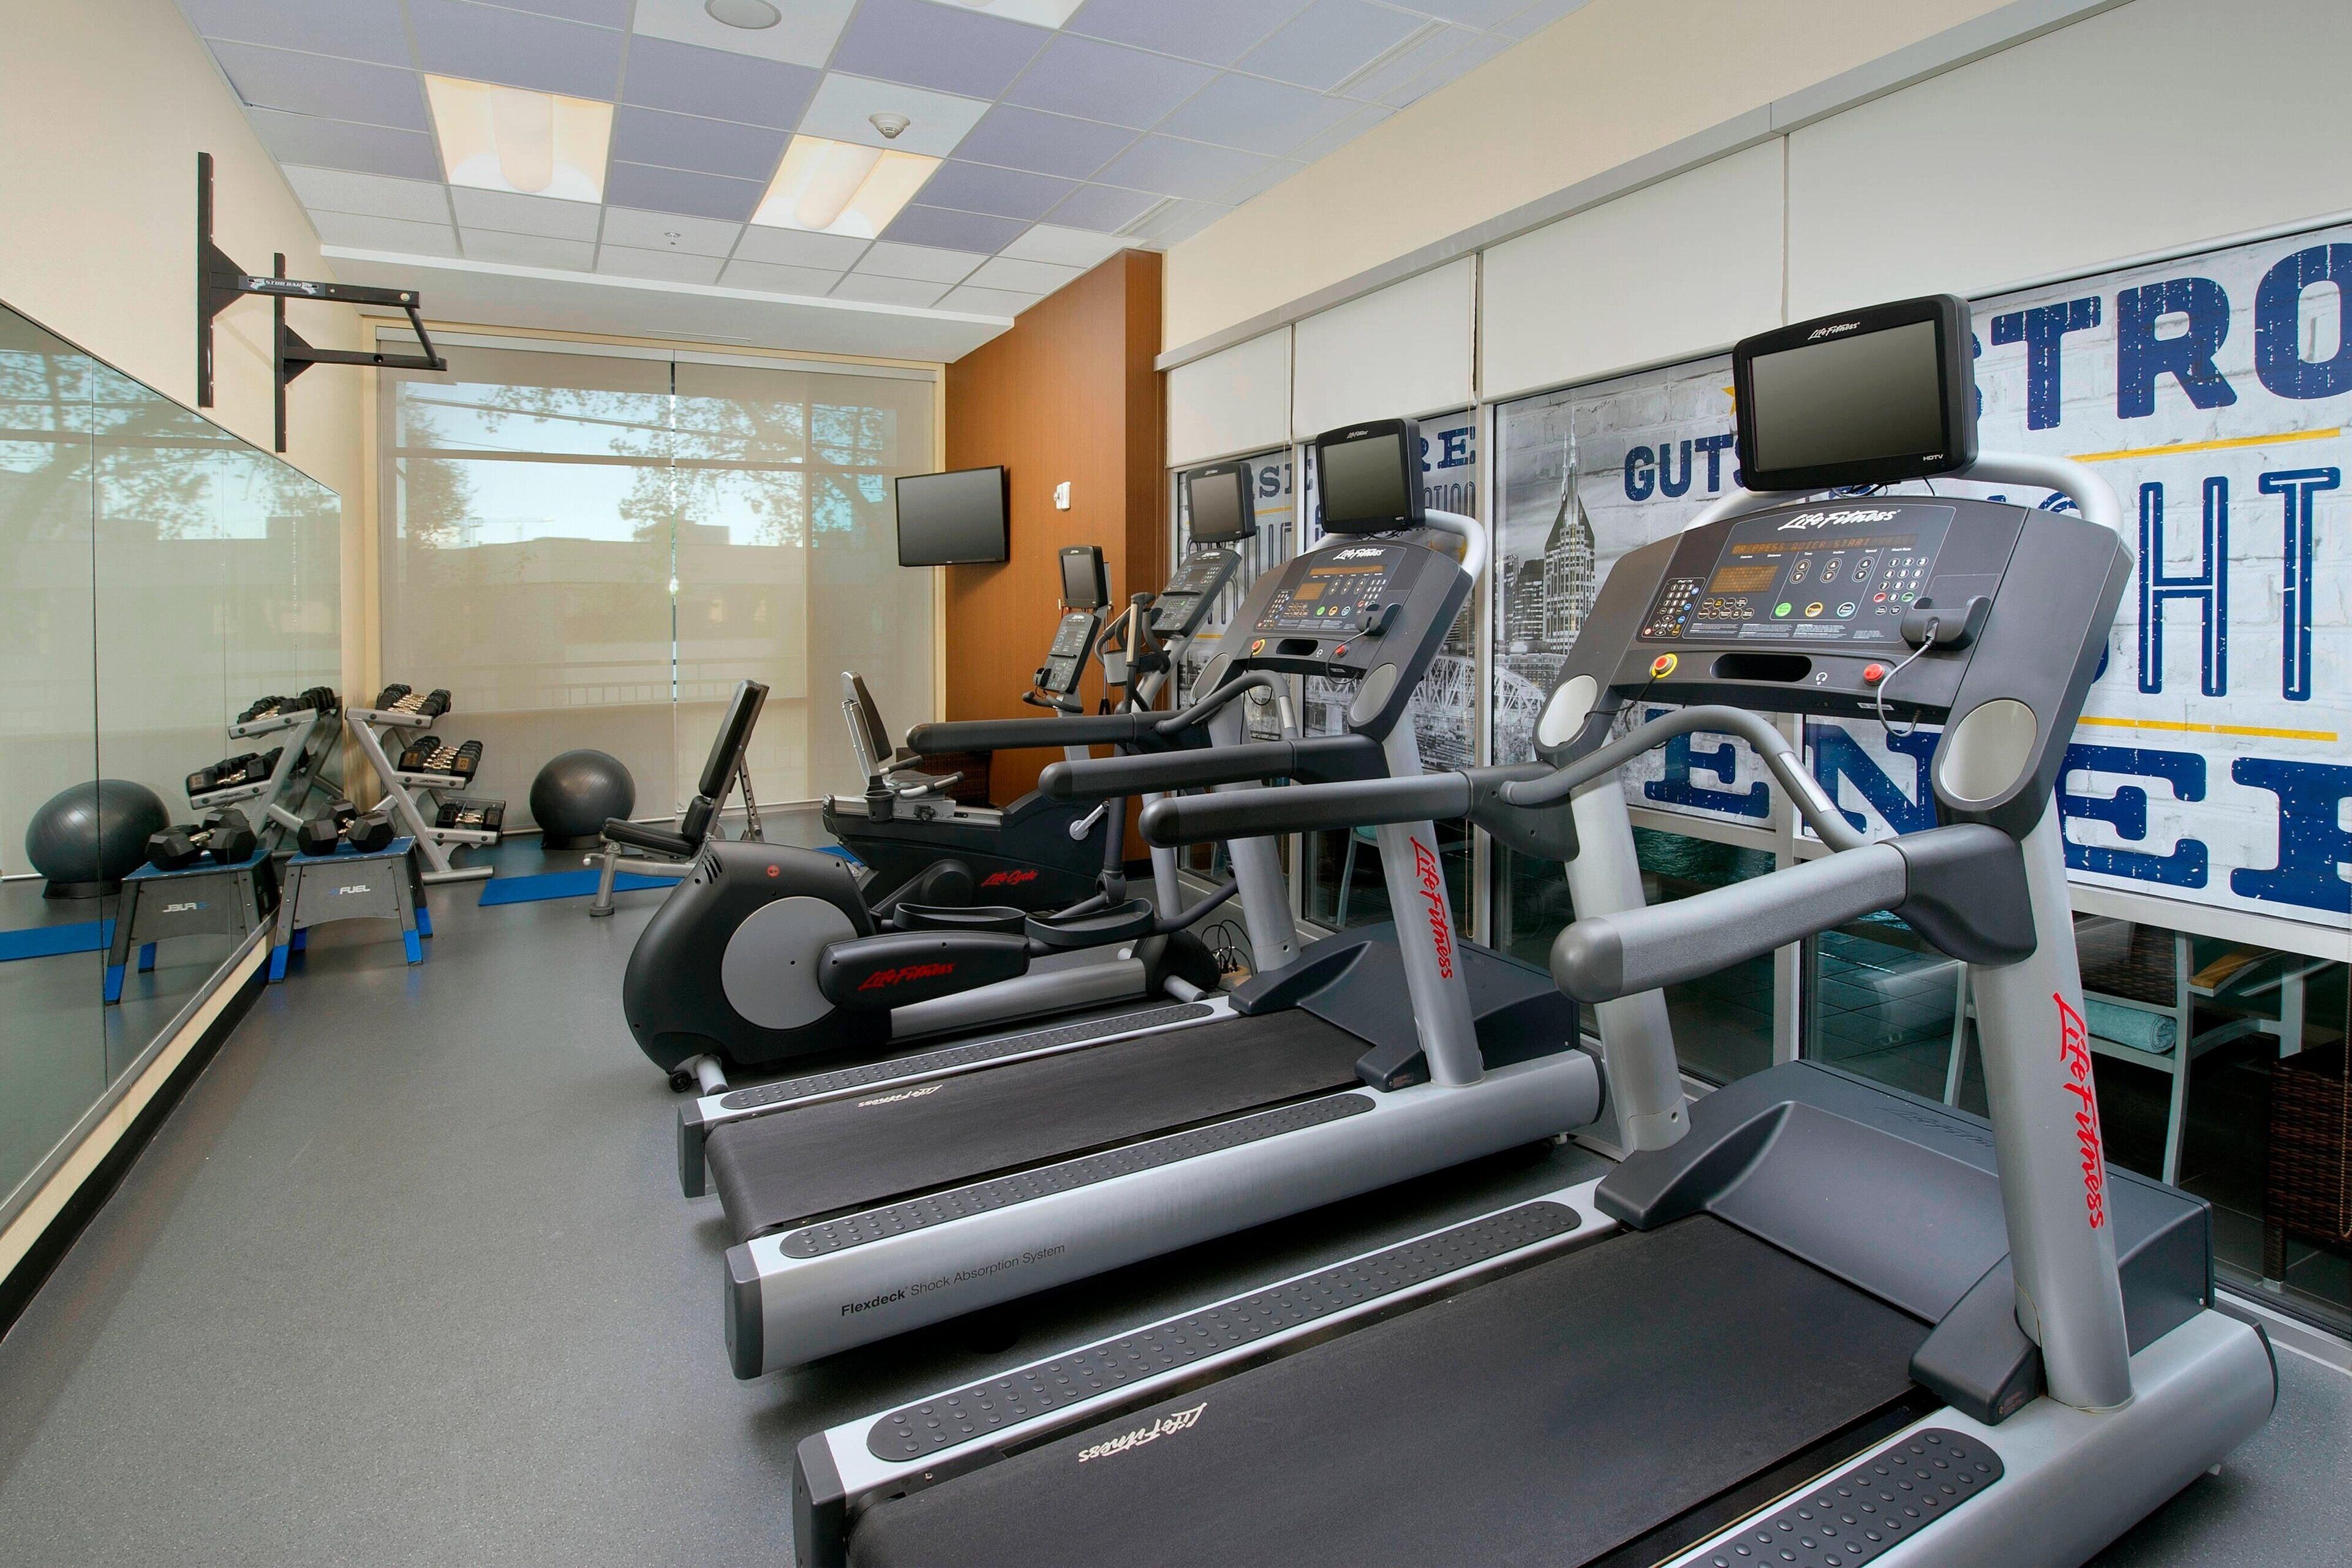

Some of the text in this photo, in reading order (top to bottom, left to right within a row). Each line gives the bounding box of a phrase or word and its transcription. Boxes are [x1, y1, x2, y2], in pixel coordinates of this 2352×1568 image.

[1973, 243, 2352, 431] TRO
[339, 884, 371, 895] FUEL
[841, 1243, 1065, 1316] Flexdeck Shock Absorption System
